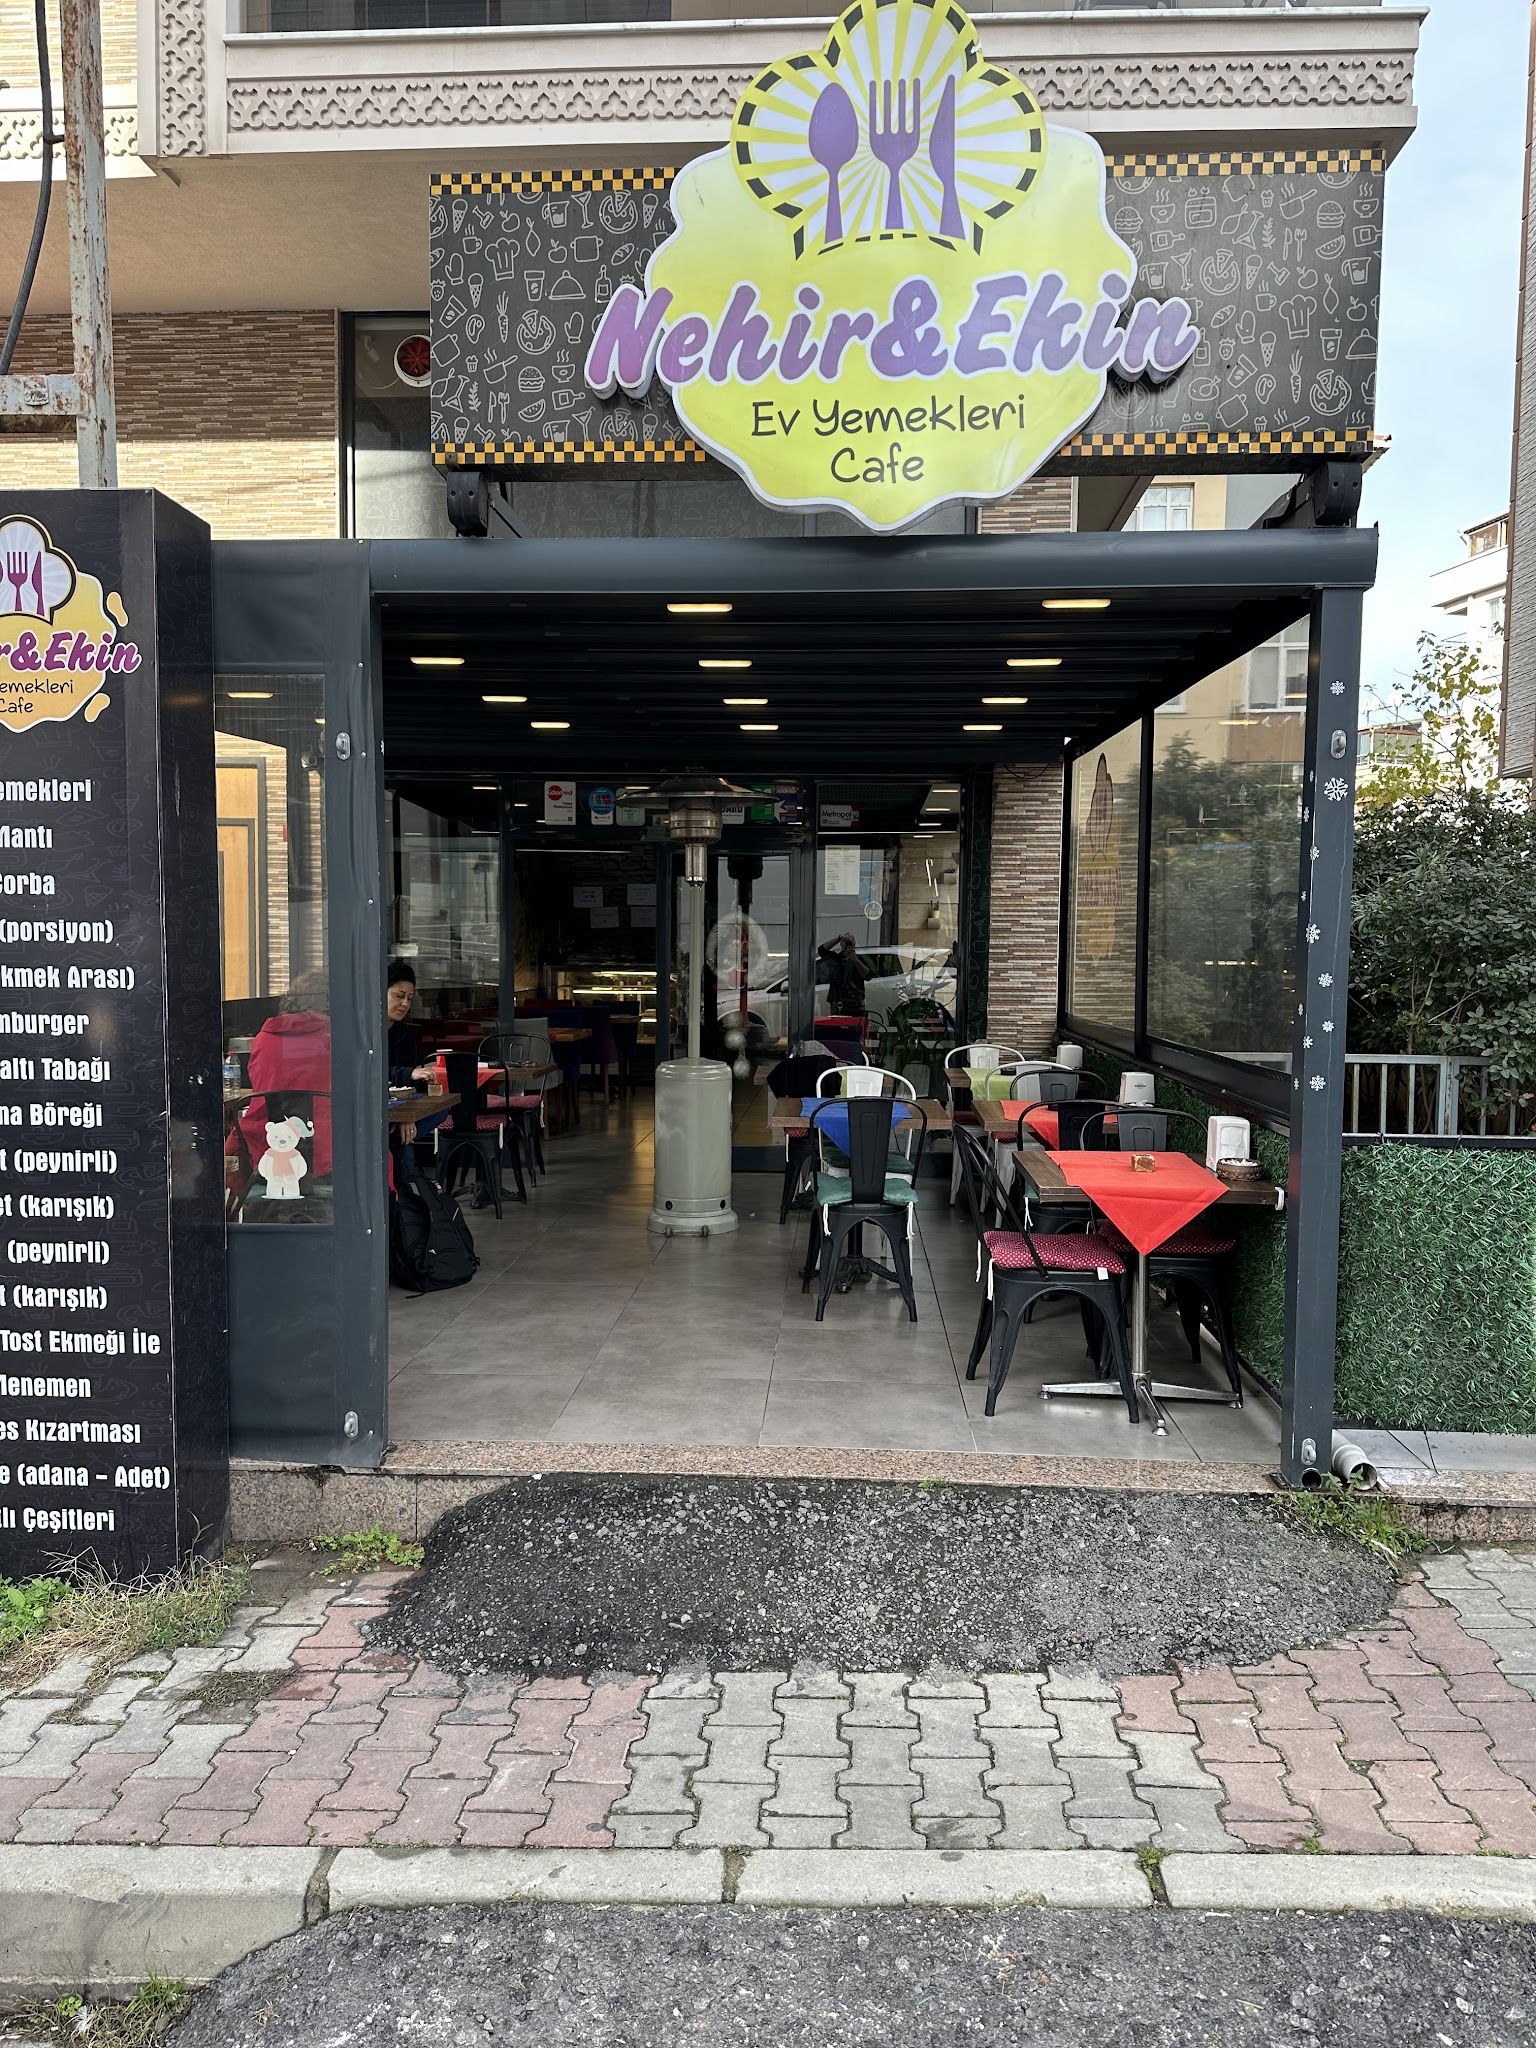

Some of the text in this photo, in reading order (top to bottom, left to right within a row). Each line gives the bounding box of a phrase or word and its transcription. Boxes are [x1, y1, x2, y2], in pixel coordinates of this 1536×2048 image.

[588, 273, 1199, 388] Nehir&Ekin
[751, 394, 1025, 437] Ev Yemekleri
[830, 443, 924, 484] Cafe
[0, 872, 56, 896] orba
[0, 918, 114, 944] (porsiyon)
[0, 965, 135, 991] kmek Arası)
[0, 1056, 111, 1083] altı Tabağı
[29, 1101, 103, 1129] Böreği
[14, 1148, 117, 1174] (peynirli)
[19, 1194, 114, 1222] (karışık)
[7, 1239, 110, 1265] (peynirli)
[13, 1284, 108, 1312] (karışık)
[0, 1327, 161, 1356] Tost Ekmeği İle
[25, 1418, 141, 1444] Kızartması
[17, 1463, 89, 1487] (adana
[114, 1465, 170, 1490] Adet)
[0, 1506, 115, 1534] lı Çeşitleri
